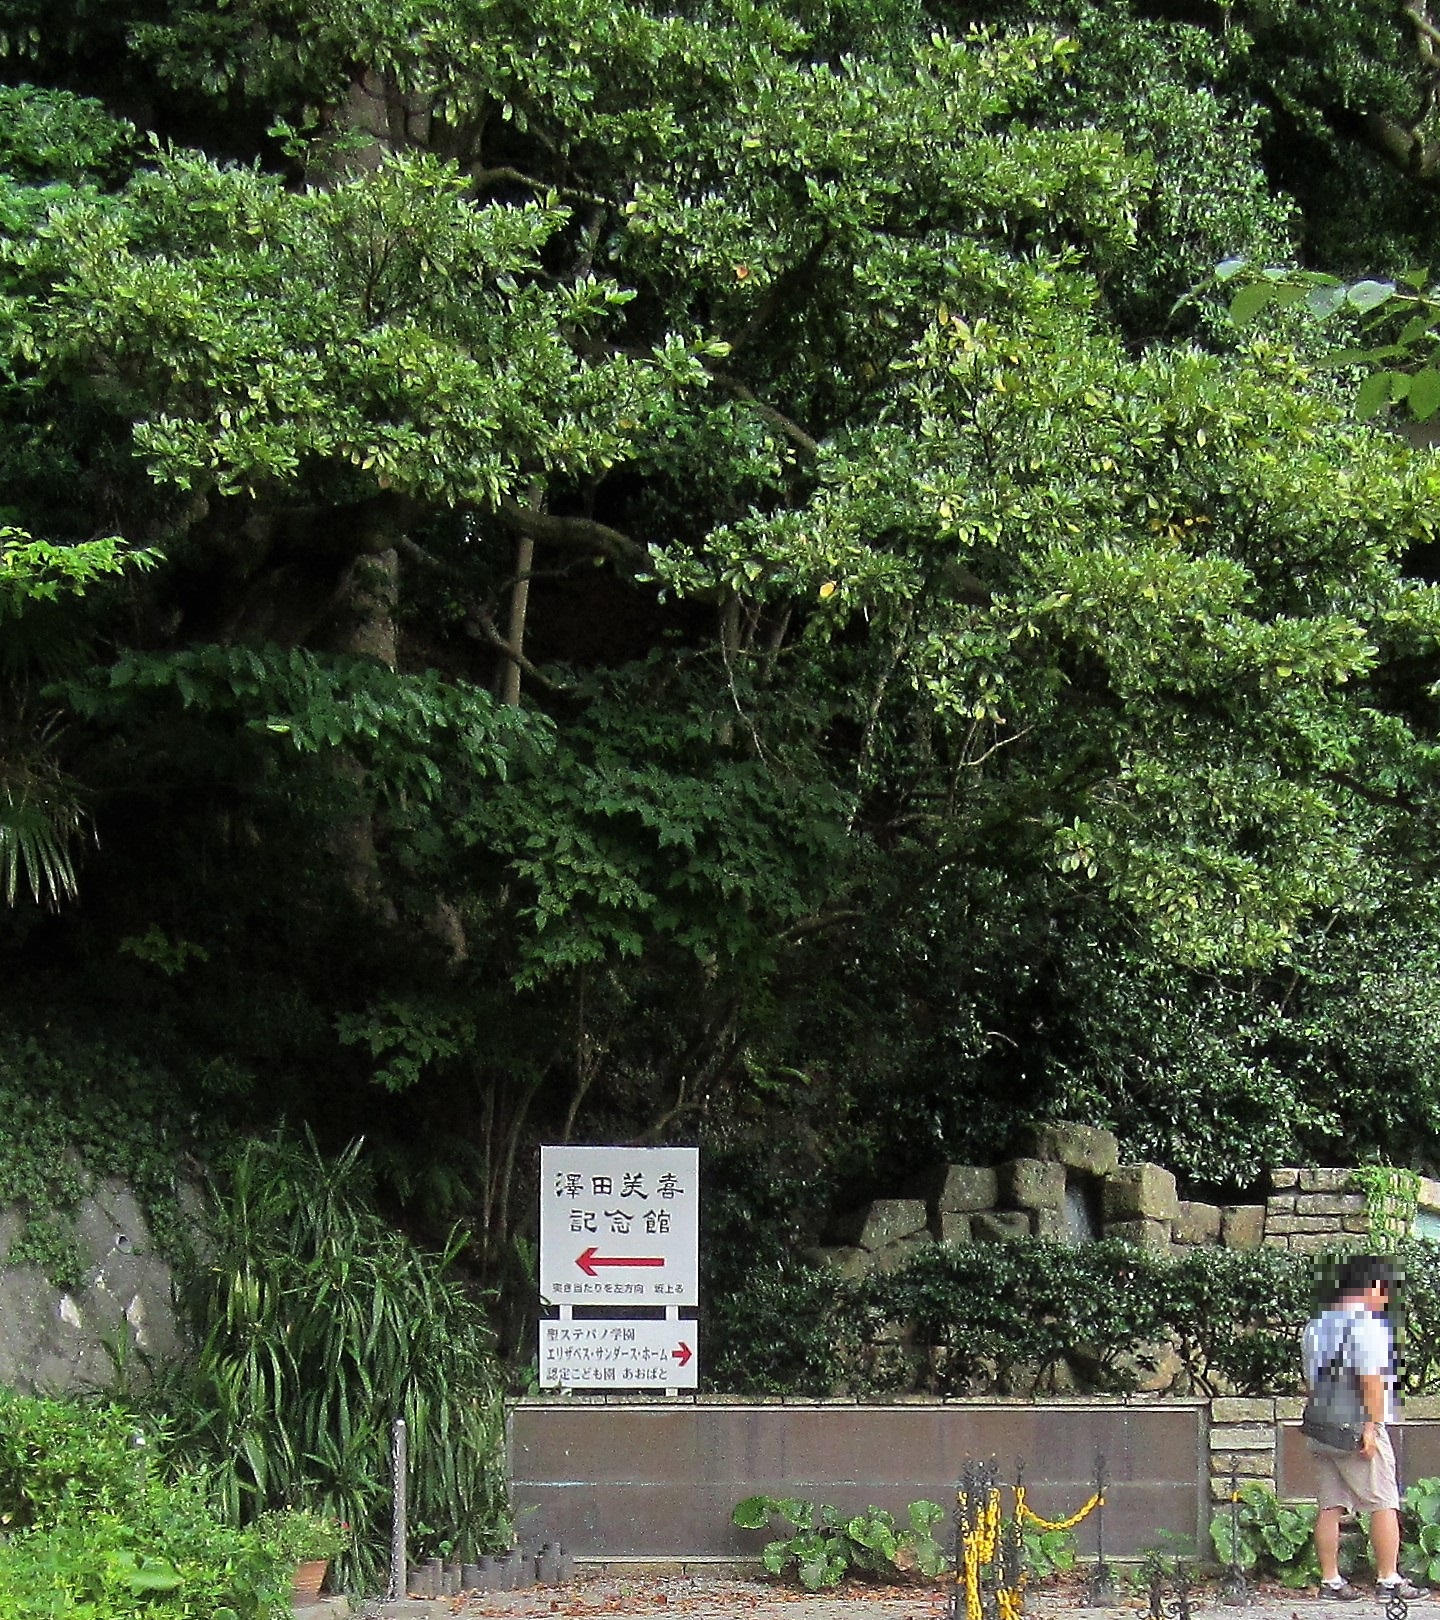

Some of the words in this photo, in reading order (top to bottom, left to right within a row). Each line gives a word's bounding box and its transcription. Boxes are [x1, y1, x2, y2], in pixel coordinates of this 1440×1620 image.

[569, 1209, 673, 1235] 記念館
[552, 1282, 644, 1295] 突き当たりを左方向
[653, 1282, 684, 1295] 坂上る
[546, 1366, 616, 1381] 認定こども園
[622, 1366, 668, 1381] あおばと
